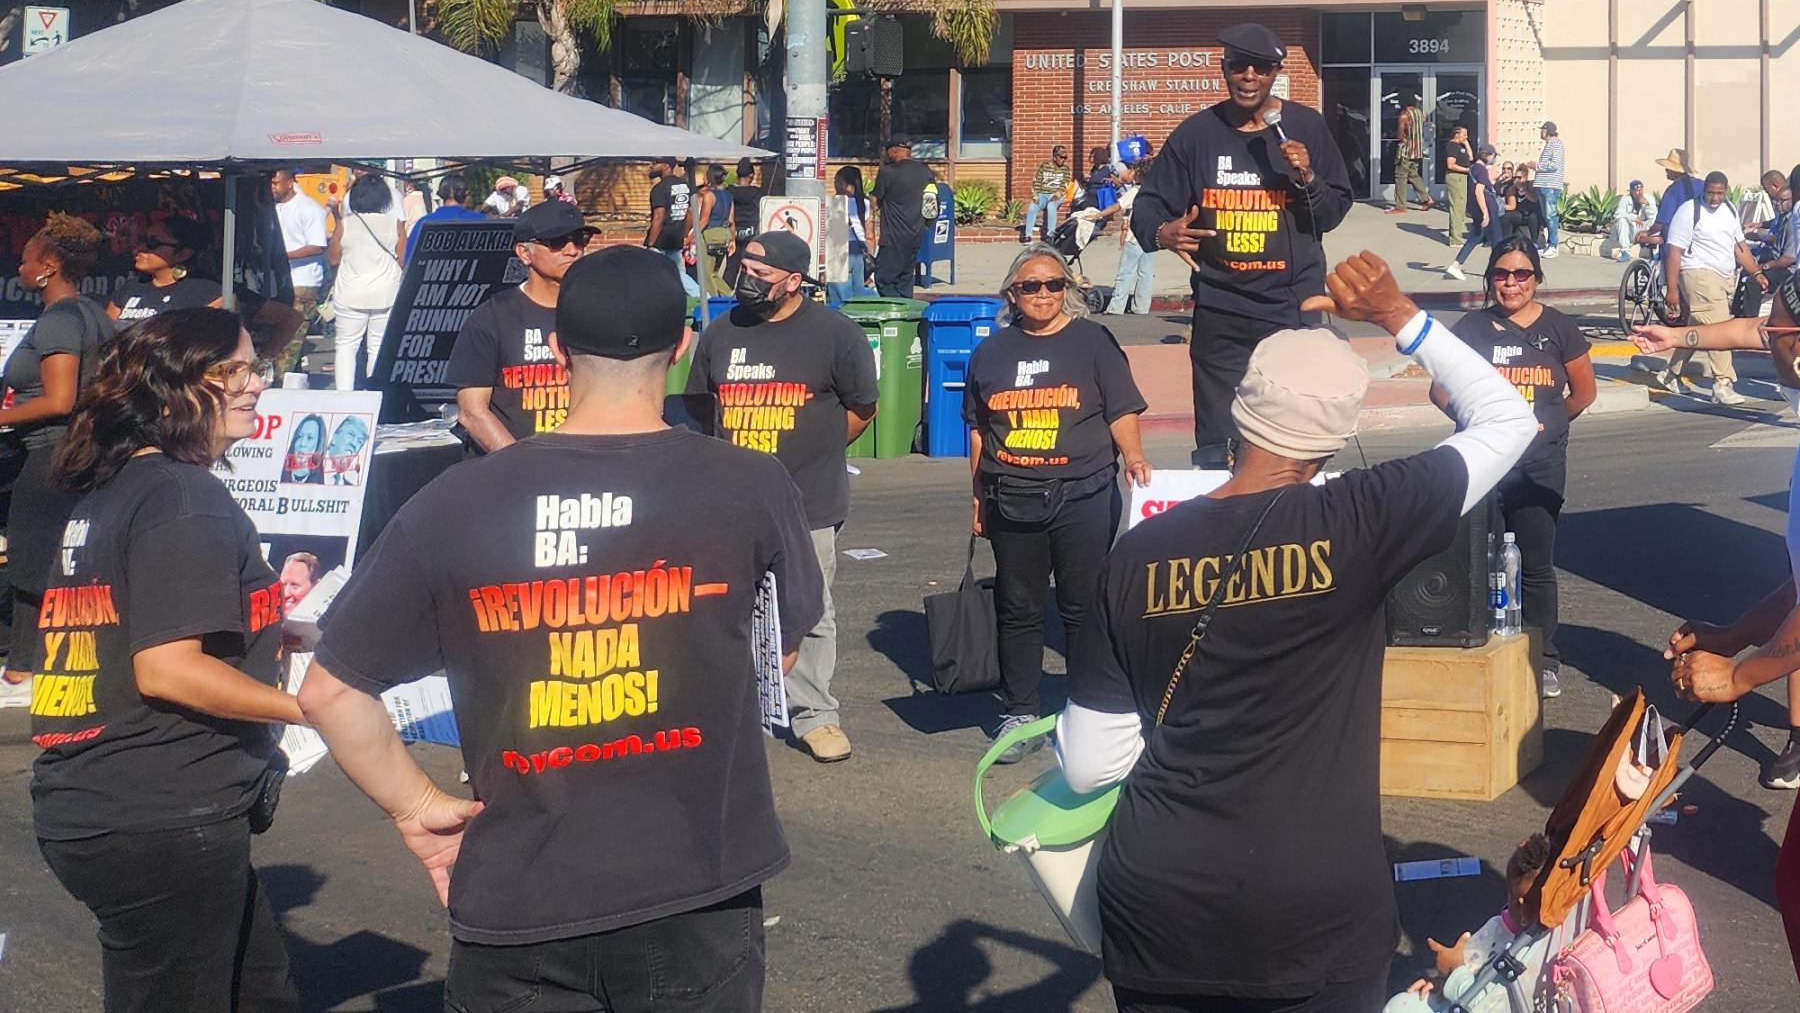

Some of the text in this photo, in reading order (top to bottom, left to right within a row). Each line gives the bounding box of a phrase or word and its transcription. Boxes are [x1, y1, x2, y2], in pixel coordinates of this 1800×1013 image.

[1408, 39, 1450, 53] 3894
[1026, 52, 1213, 69] UNITED SATES POST
[1089, 79, 1220, 92] CRESHAW STATION
[1070, 104, 1092, 115] LOS
[1218, 156, 1232, 170] BA
[1217, 171, 1260, 186] Speaks:
[1216, 210, 1278, 231] NOTHING
[421, 230, 515, 251] BOB AVAKIA
[1227, 233, 1265, 253] LESS!
[413, 284, 492, 306] AM NOT
[397, 336, 435, 357] FOR
[525, 329, 543, 344] BA
[731, 348, 747, 364] BA
[390, 360, 449, 383] PRESI
[727, 364, 776, 381] Speaks:
[523, 387, 569, 410] NOTH
[535, 409, 567, 433] LES
[723, 407, 795, 431] NOTHING
[1008, 409, 1059, 428] Y NADA
[1005, 429, 1057, 450] MENOS!
[226, 447, 273, 458] LOWING
[224, 479, 278, 493] RGEOIS
[536, 493, 633, 531] Habla
[535, 531, 588, 568] BA:
[1146, 539, 1334, 615] LEGENDS
[45, 632, 65, 671] Y
[549, 623, 640, 679] NADA
[529, 670, 659, 729] MENOS!
